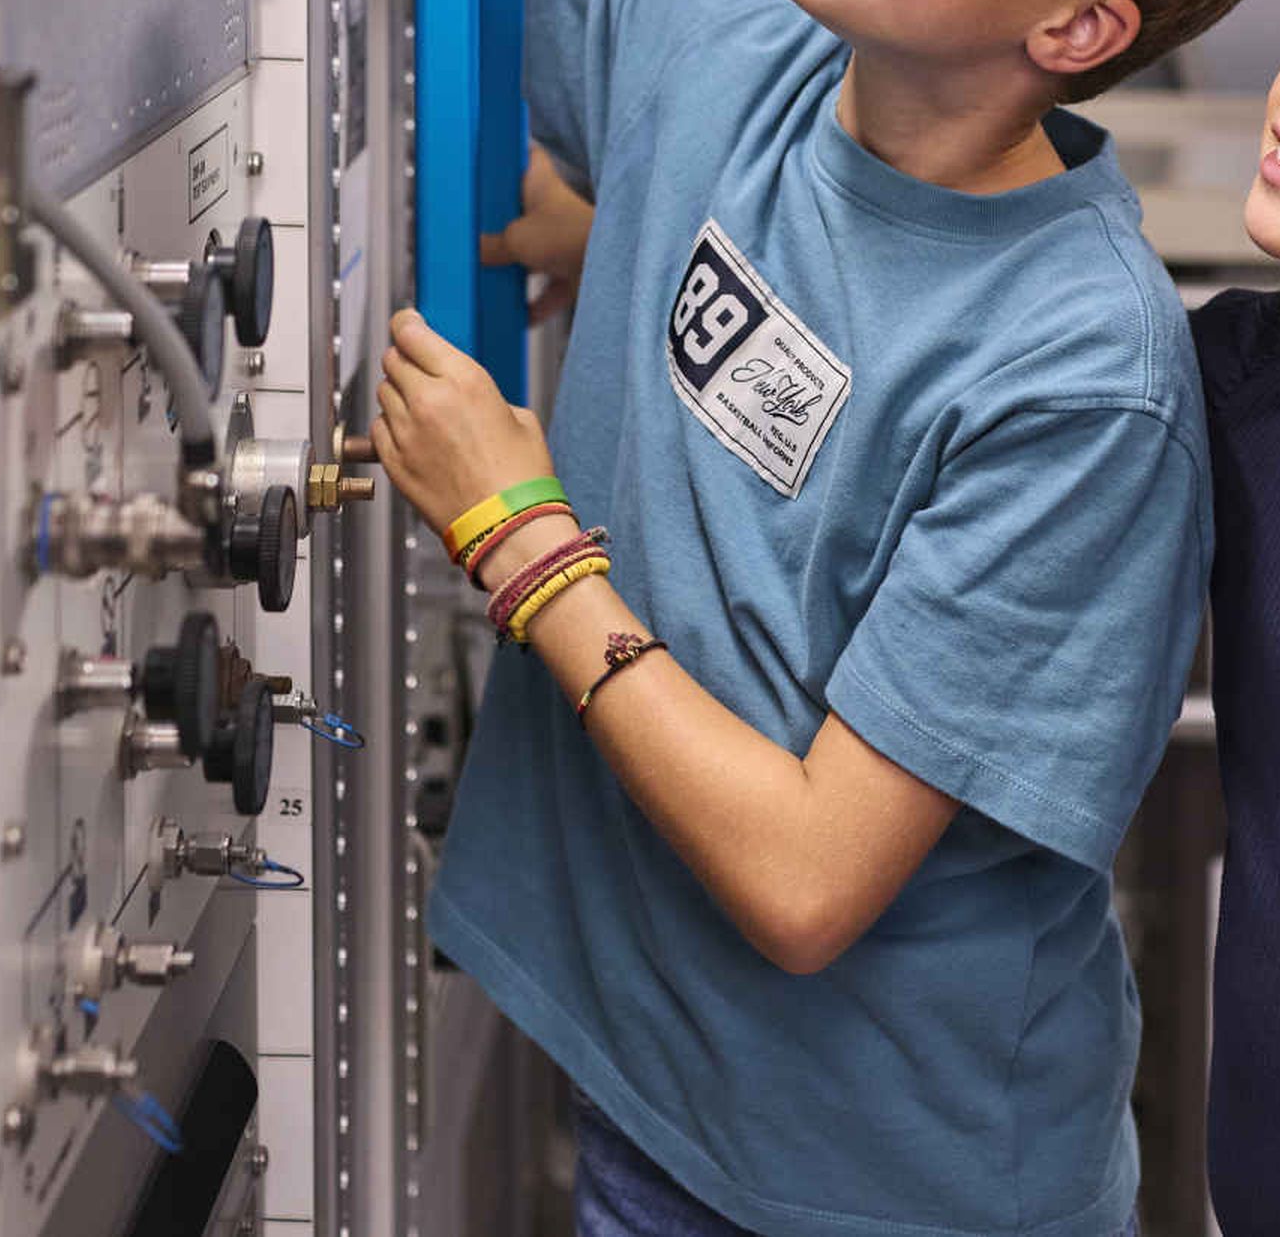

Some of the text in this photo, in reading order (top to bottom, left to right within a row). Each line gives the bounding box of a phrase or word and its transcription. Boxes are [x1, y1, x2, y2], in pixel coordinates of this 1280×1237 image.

[673, 262, 749, 365] 89
[761, 374, 823, 427] York
[279, 798, 302, 817] 25
